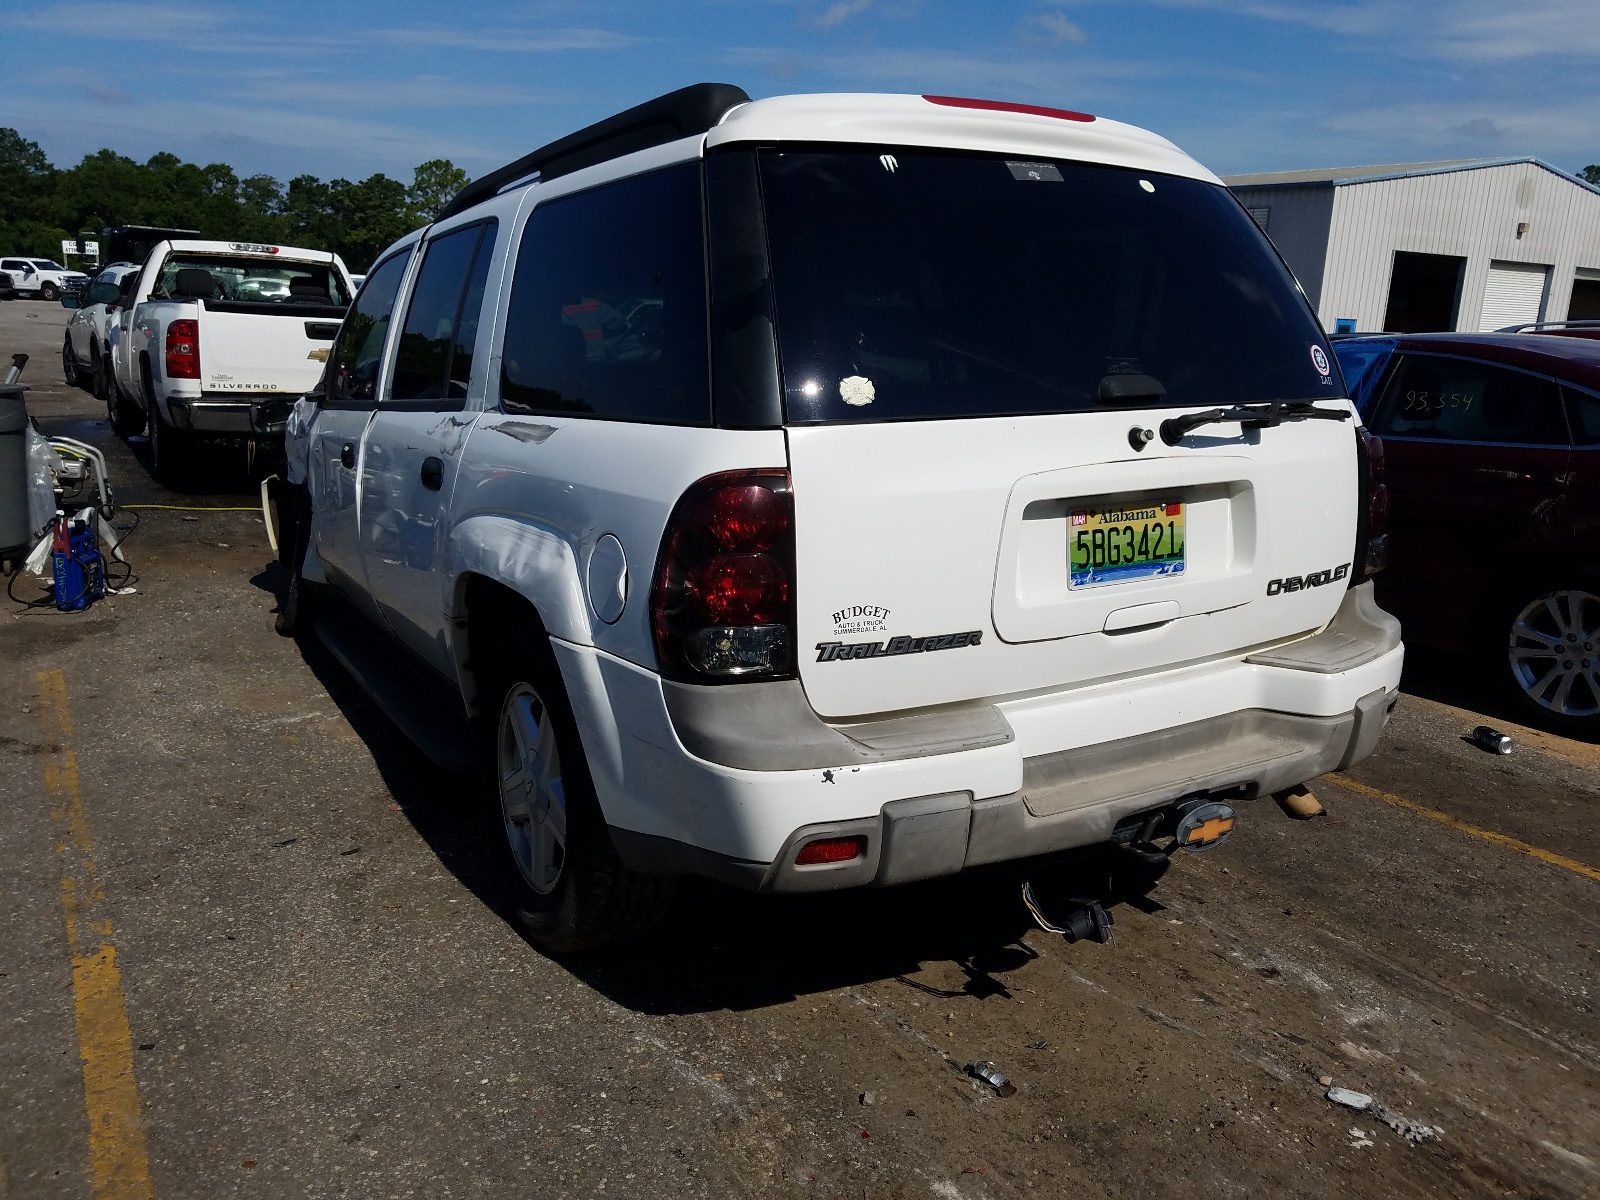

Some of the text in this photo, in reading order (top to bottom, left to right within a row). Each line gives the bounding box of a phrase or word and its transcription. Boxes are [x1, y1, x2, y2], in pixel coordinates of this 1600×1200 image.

[1099, 508, 1157, 525] Alabama
[1077, 521, 1179, 569] 5BG3421
[1267, 562, 1351, 596] CHEVROLET
[831, 604, 891, 624] BUDGET
[863, 619, 884, 627] TRUCK
